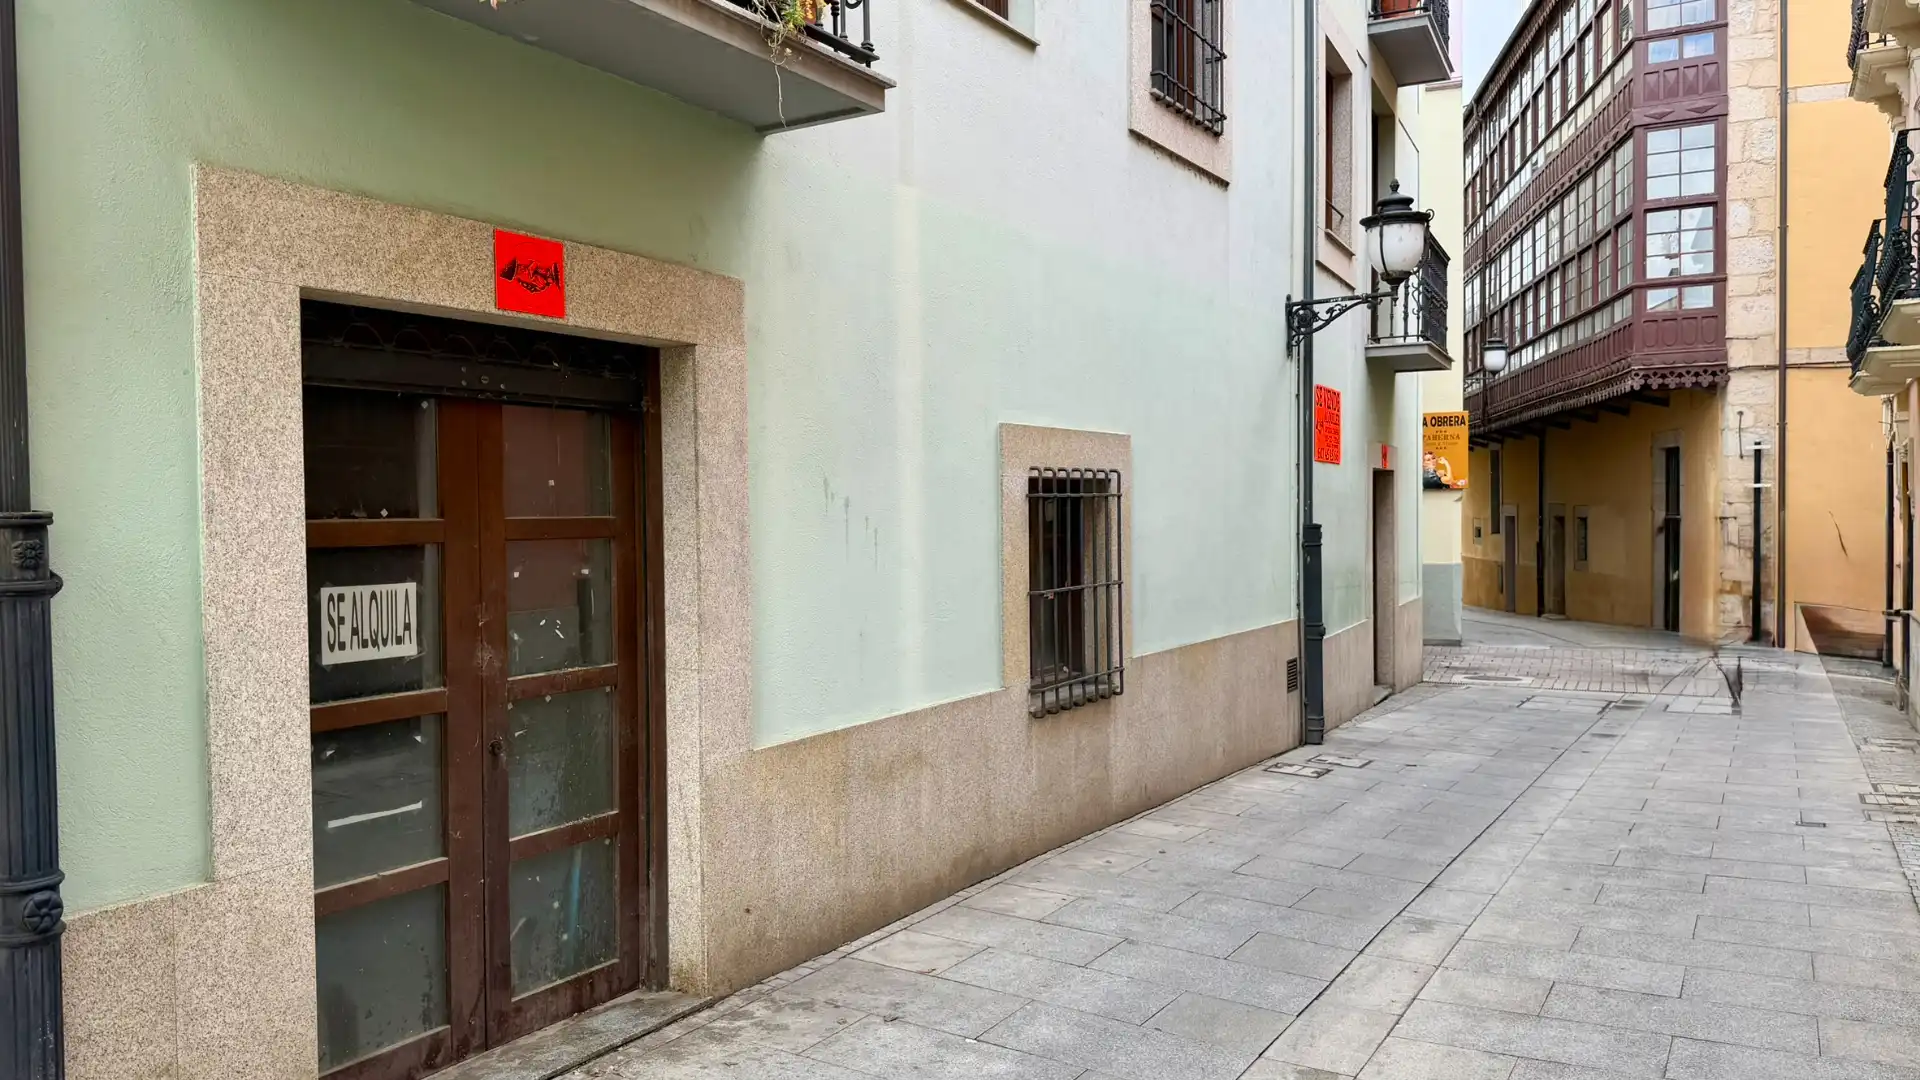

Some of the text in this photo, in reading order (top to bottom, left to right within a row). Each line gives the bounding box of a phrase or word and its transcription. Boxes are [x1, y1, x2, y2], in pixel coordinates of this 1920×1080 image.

[1423, 415, 1466, 427] A OBRERA
[327, 588, 412, 653] SE ALQUILA
